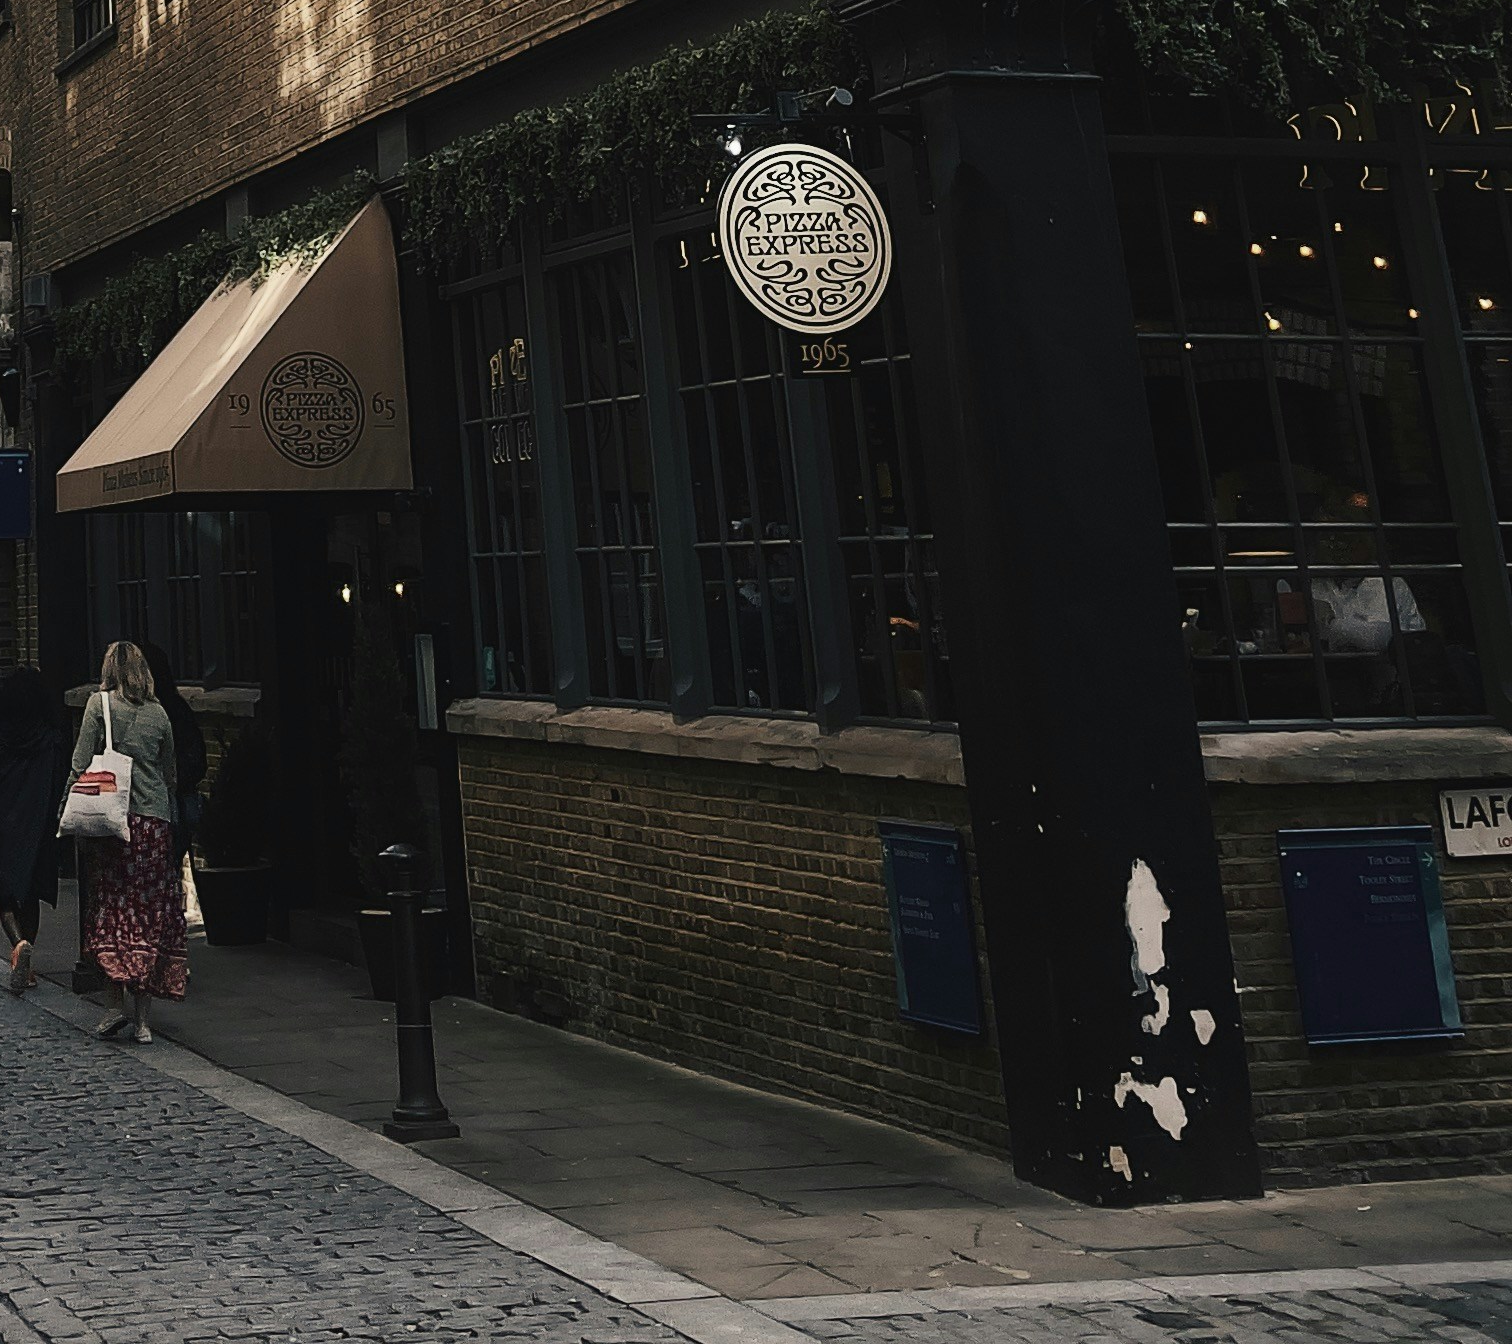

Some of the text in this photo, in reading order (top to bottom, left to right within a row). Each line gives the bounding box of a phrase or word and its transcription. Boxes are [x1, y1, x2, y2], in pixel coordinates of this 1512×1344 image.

[763, 211, 844, 234] PIZZA
[745, 232, 870, 257] EXPRESS
[800, 337, 851, 369] 1965
[285, 392, 338, 407] PIZZA
[271, 407, 355, 422] EXPRESS
[1445, 795, 1512, 830] LAF
